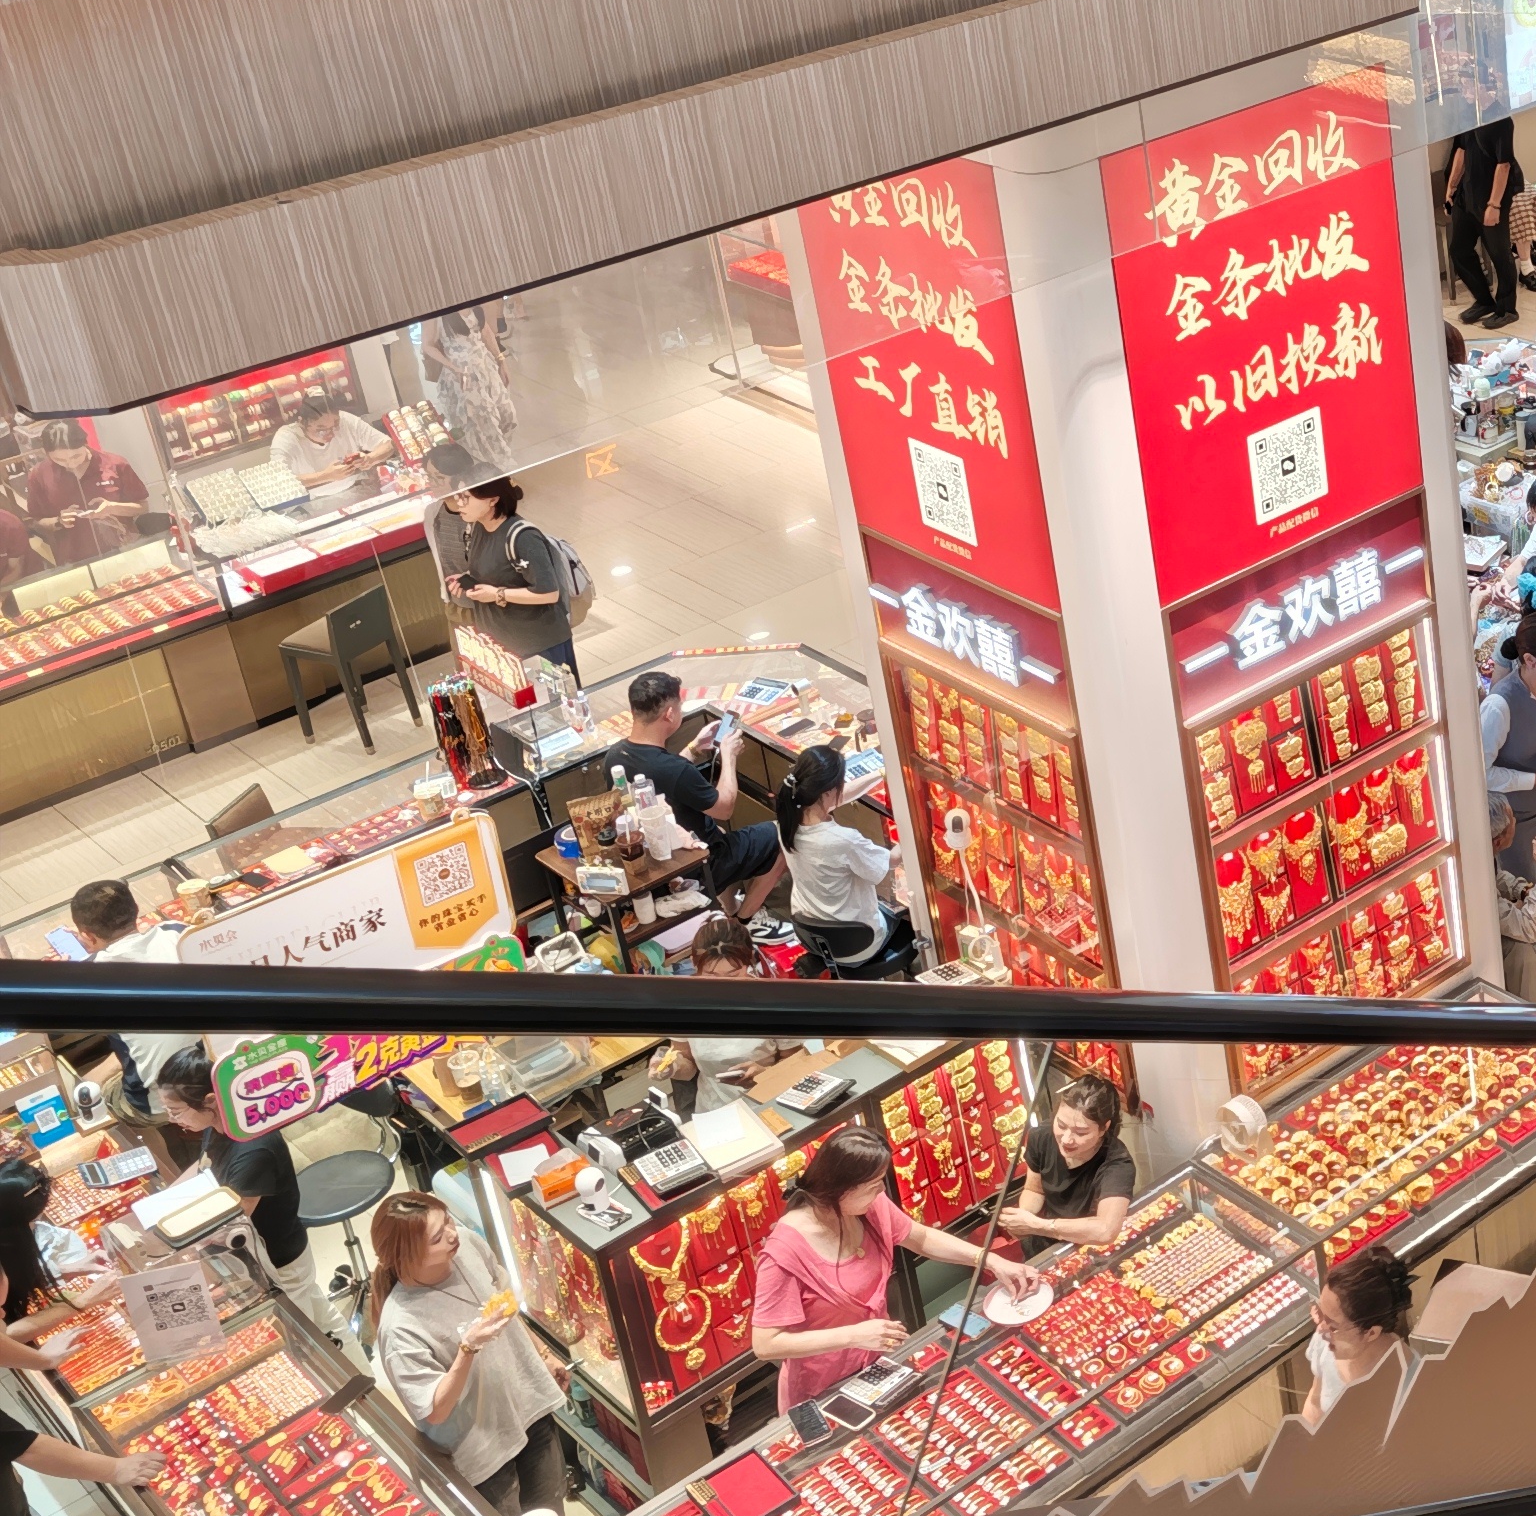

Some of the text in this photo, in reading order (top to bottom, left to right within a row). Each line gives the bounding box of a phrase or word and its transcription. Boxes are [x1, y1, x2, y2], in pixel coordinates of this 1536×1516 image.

[1146, 110, 1361, 248] 黄金回收
[838, 248, 995, 366] 金条批发
[1166, 210, 1371, 342] 金条批发
[853, 355, 1009, 460] 工厂直销
[1175, 302, 1385, 432] 以旧换新
